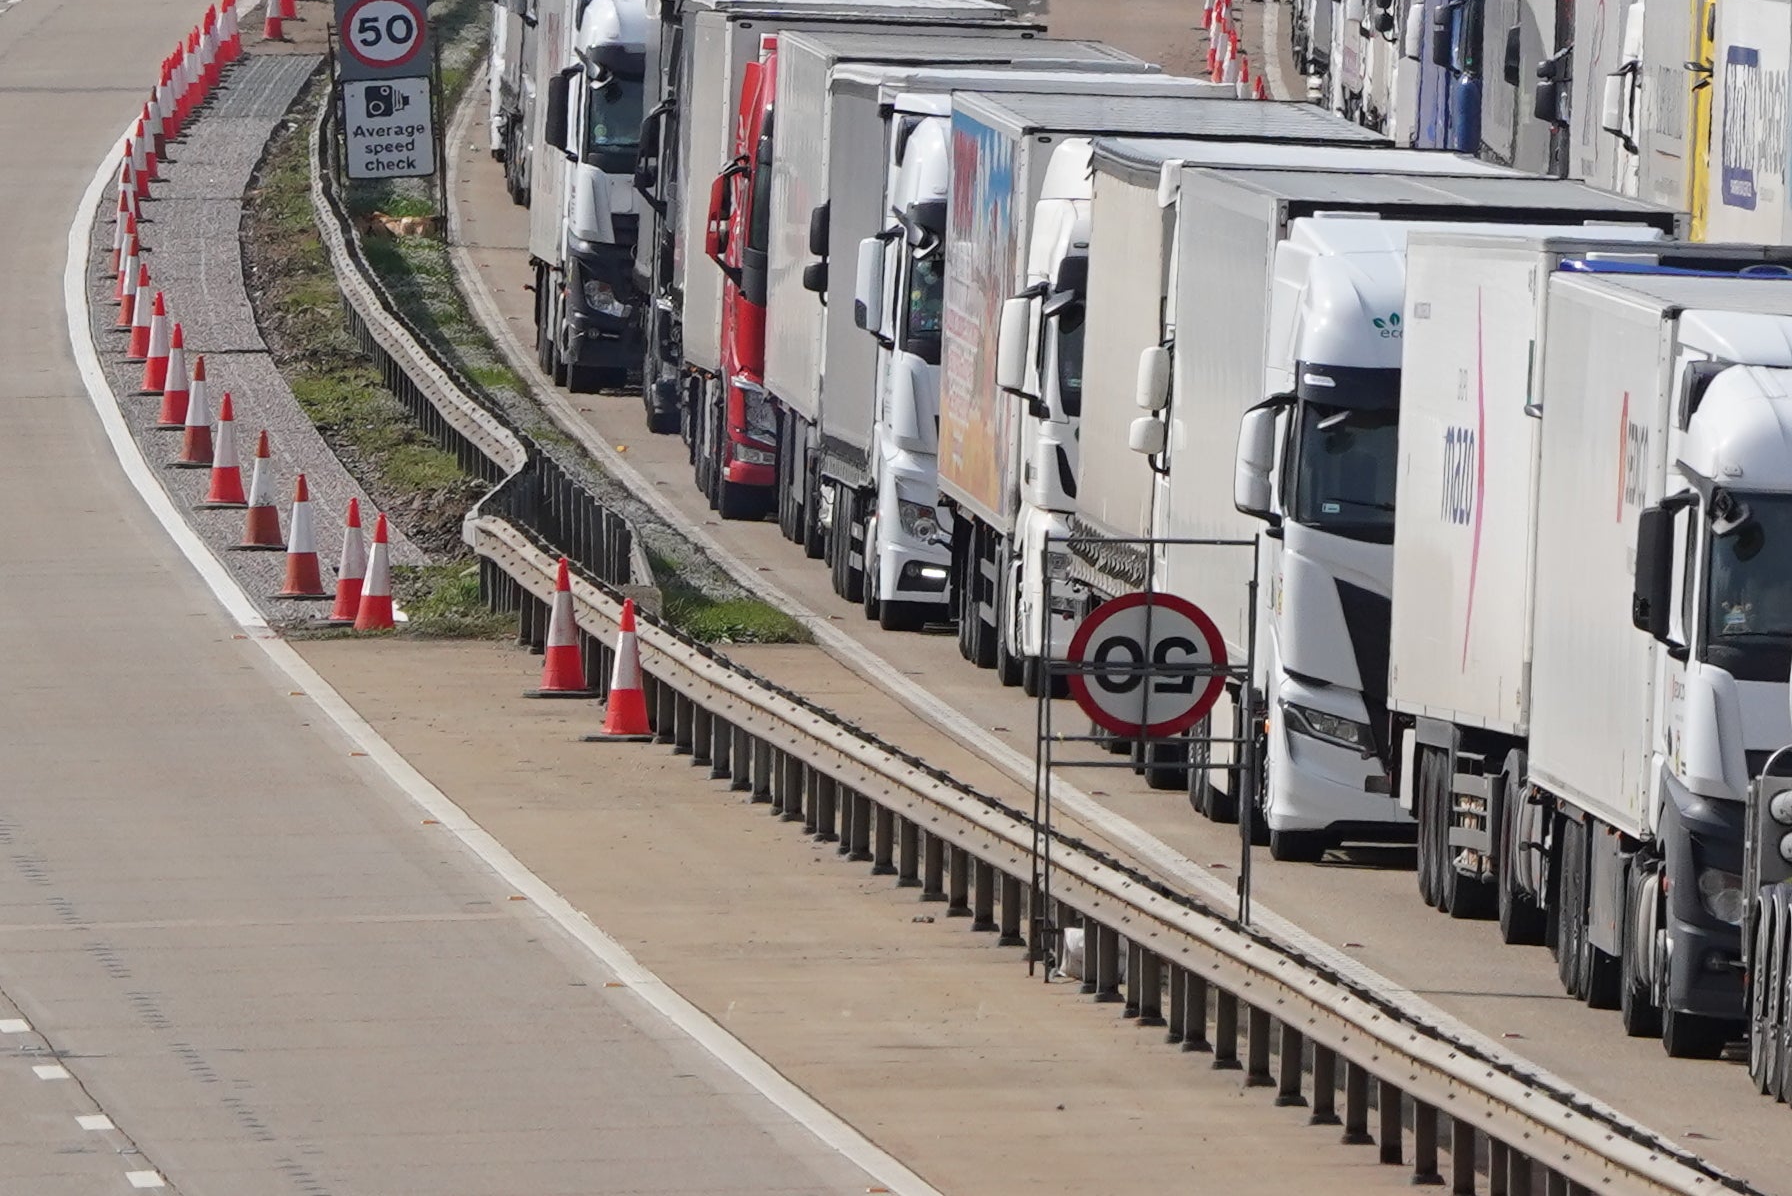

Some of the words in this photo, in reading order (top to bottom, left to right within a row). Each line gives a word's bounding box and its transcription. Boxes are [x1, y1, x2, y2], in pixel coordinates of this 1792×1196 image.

[358, 14, 414, 47] 50
[352, 123, 425, 139] Average
[364, 139, 415, 156] speed
[364, 156, 416, 172] check
[1440, 426, 1475, 526] mazo
[1094, 635, 1198, 694] 50
